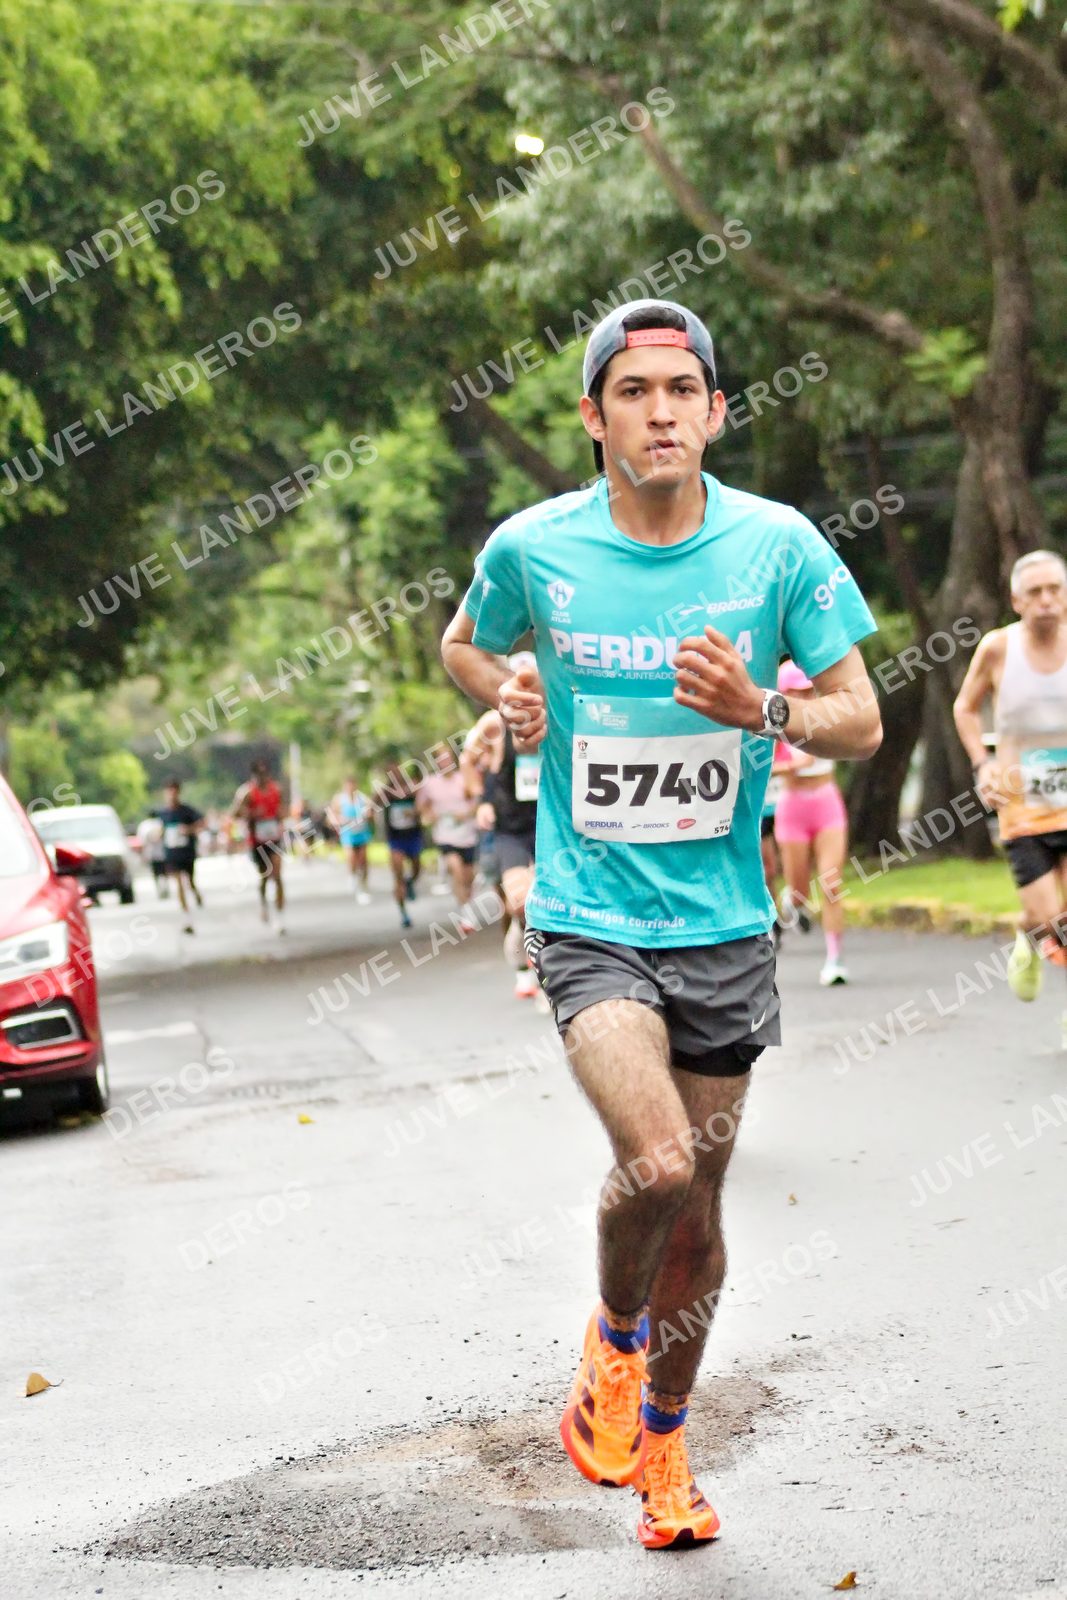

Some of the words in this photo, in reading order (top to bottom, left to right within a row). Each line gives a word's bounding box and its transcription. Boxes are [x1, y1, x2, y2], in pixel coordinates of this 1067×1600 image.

[706, 594, 765, 615] BROOKS
[549, 627, 753, 671] PERDA
[584, 759, 730, 807] 5740
[584, 820, 624, 829] PERDURA
[642, 822, 671, 830] BROOKS
[714, 824, 730, 835] 574
[581, 909, 625, 925] amigos
[628, 914, 685, 929] corriendo
